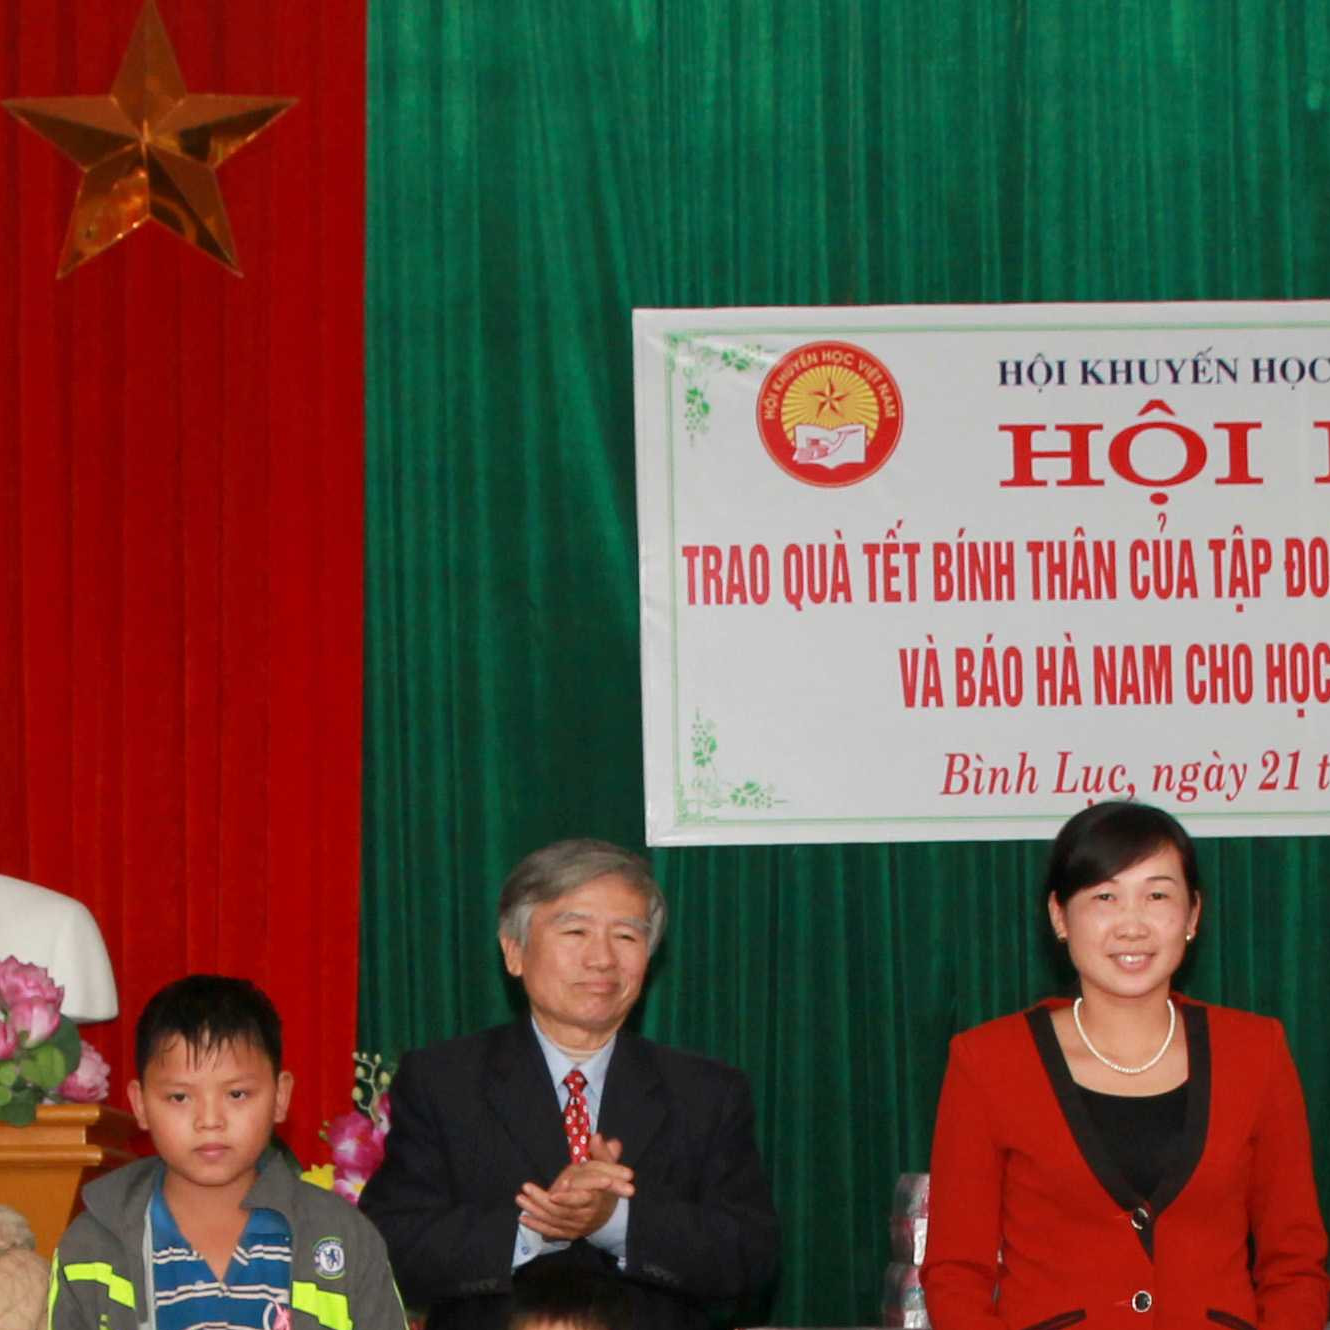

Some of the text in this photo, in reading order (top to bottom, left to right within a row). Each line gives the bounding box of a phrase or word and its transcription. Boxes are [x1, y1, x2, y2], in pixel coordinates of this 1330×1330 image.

[821, 351, 855, 366] HỌC
[1000, 352, 1065, 388] HỘI
[1082, 348, 1237, 384] KHUYẾN
[1253, 358, 1330, 392] HỌC
[999, 399, 1263, 506] HỘI
[682, 544, 771, 606] TRAO
[783, 531, 853, 611] QUÀ
[863, 522, 922, 603] TẾT
[933, 528, 1016, 603] BÍNH
[1026, 527, 1118, 602] THÂN
[1130, 512, 1199, 600] CỦA
[1208, 525, 1273, 613] TẬP
[899, 635, 944, 709] VÀ
[955, 635, 1024, 708] BÁO
[1036, 632, 1081, 707] HÀ
[1093, 644, 1174, 705] NAM
[1186, 643, 1254, 705] CHO
[943, 752, 1037, 796] Bình
[1054, 752, 1136, 806] Lục,
[1152, 752, 1248, 803] ngày
[1258, 749, 1300, 792] 21
